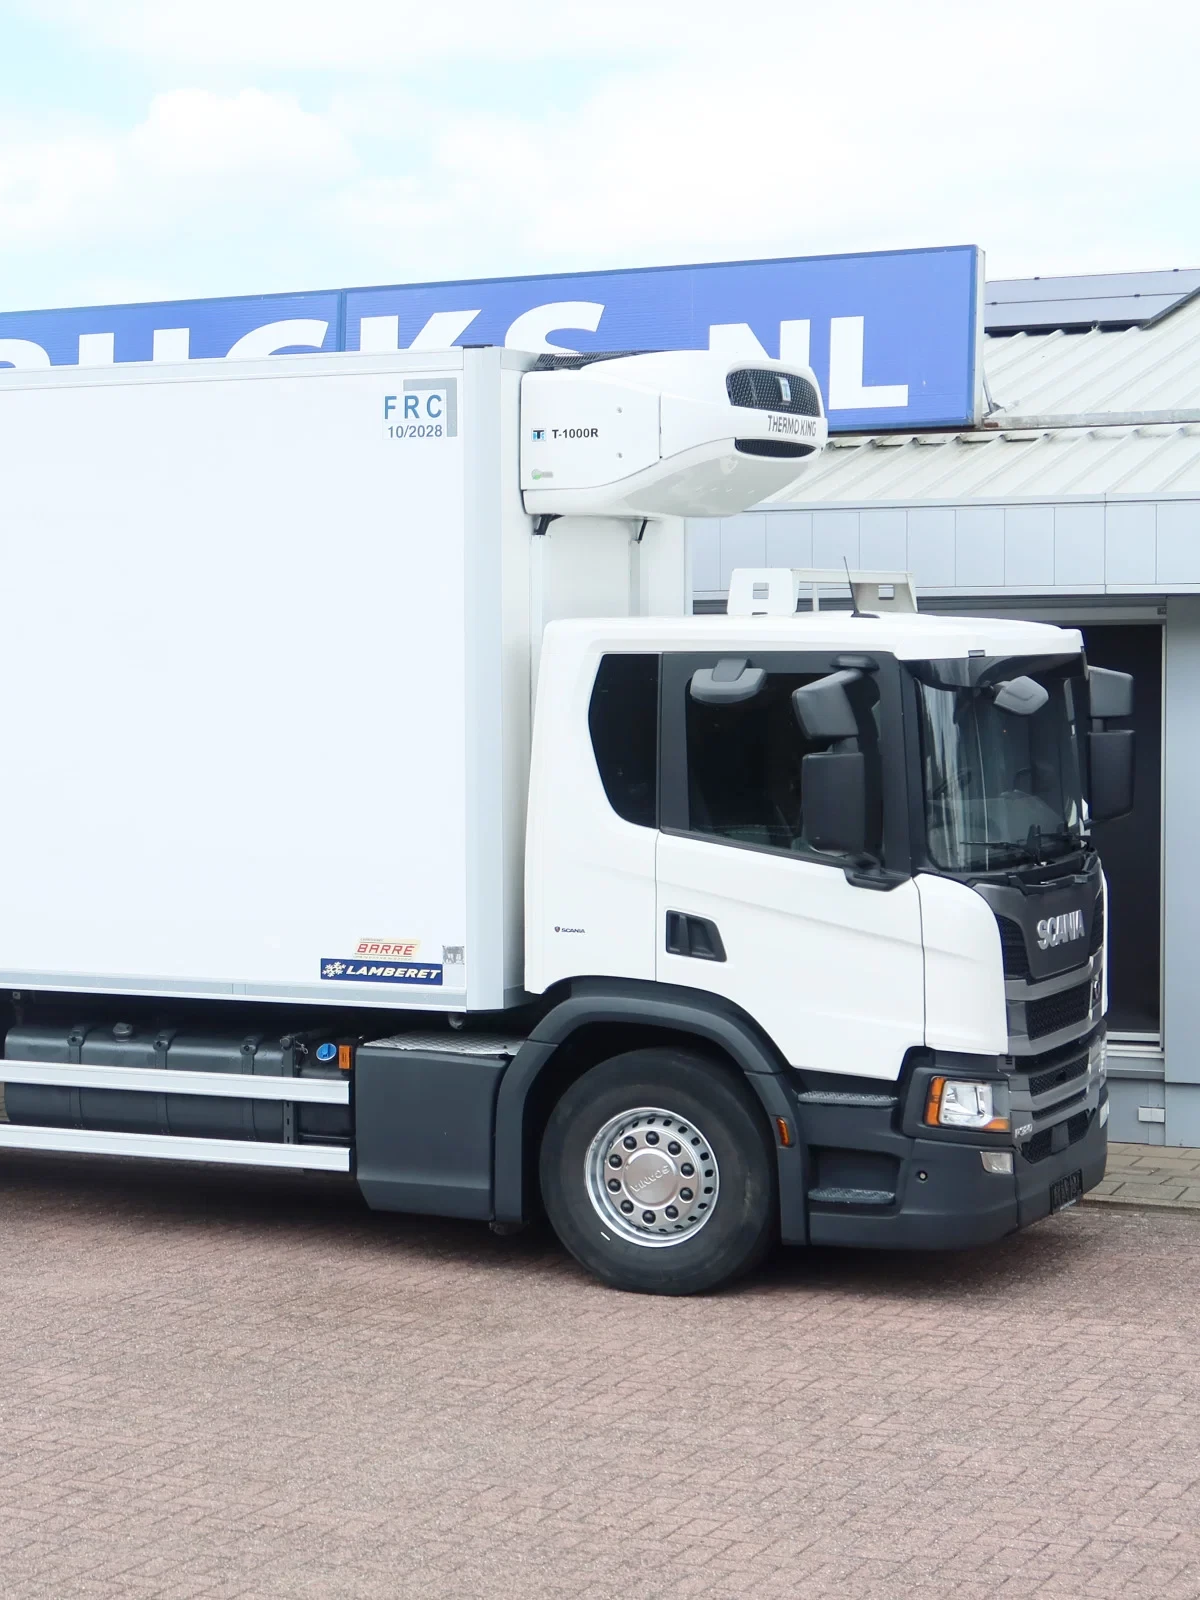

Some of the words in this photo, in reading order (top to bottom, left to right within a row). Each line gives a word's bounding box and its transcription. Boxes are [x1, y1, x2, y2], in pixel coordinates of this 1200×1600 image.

[384, 394, 443, 420] FRC
[387, 424, 443, 439] 10/2028
[551, 427, 599, 439] T-1000R
[767, 415, 800, 434] THERMO
[800, 420, 817, 437] KING
[1037, 909, 1085, 950] SCANIA
[357, 943, 416, 956] BARRE
[346, 965, 442, 980] LAMBERET
